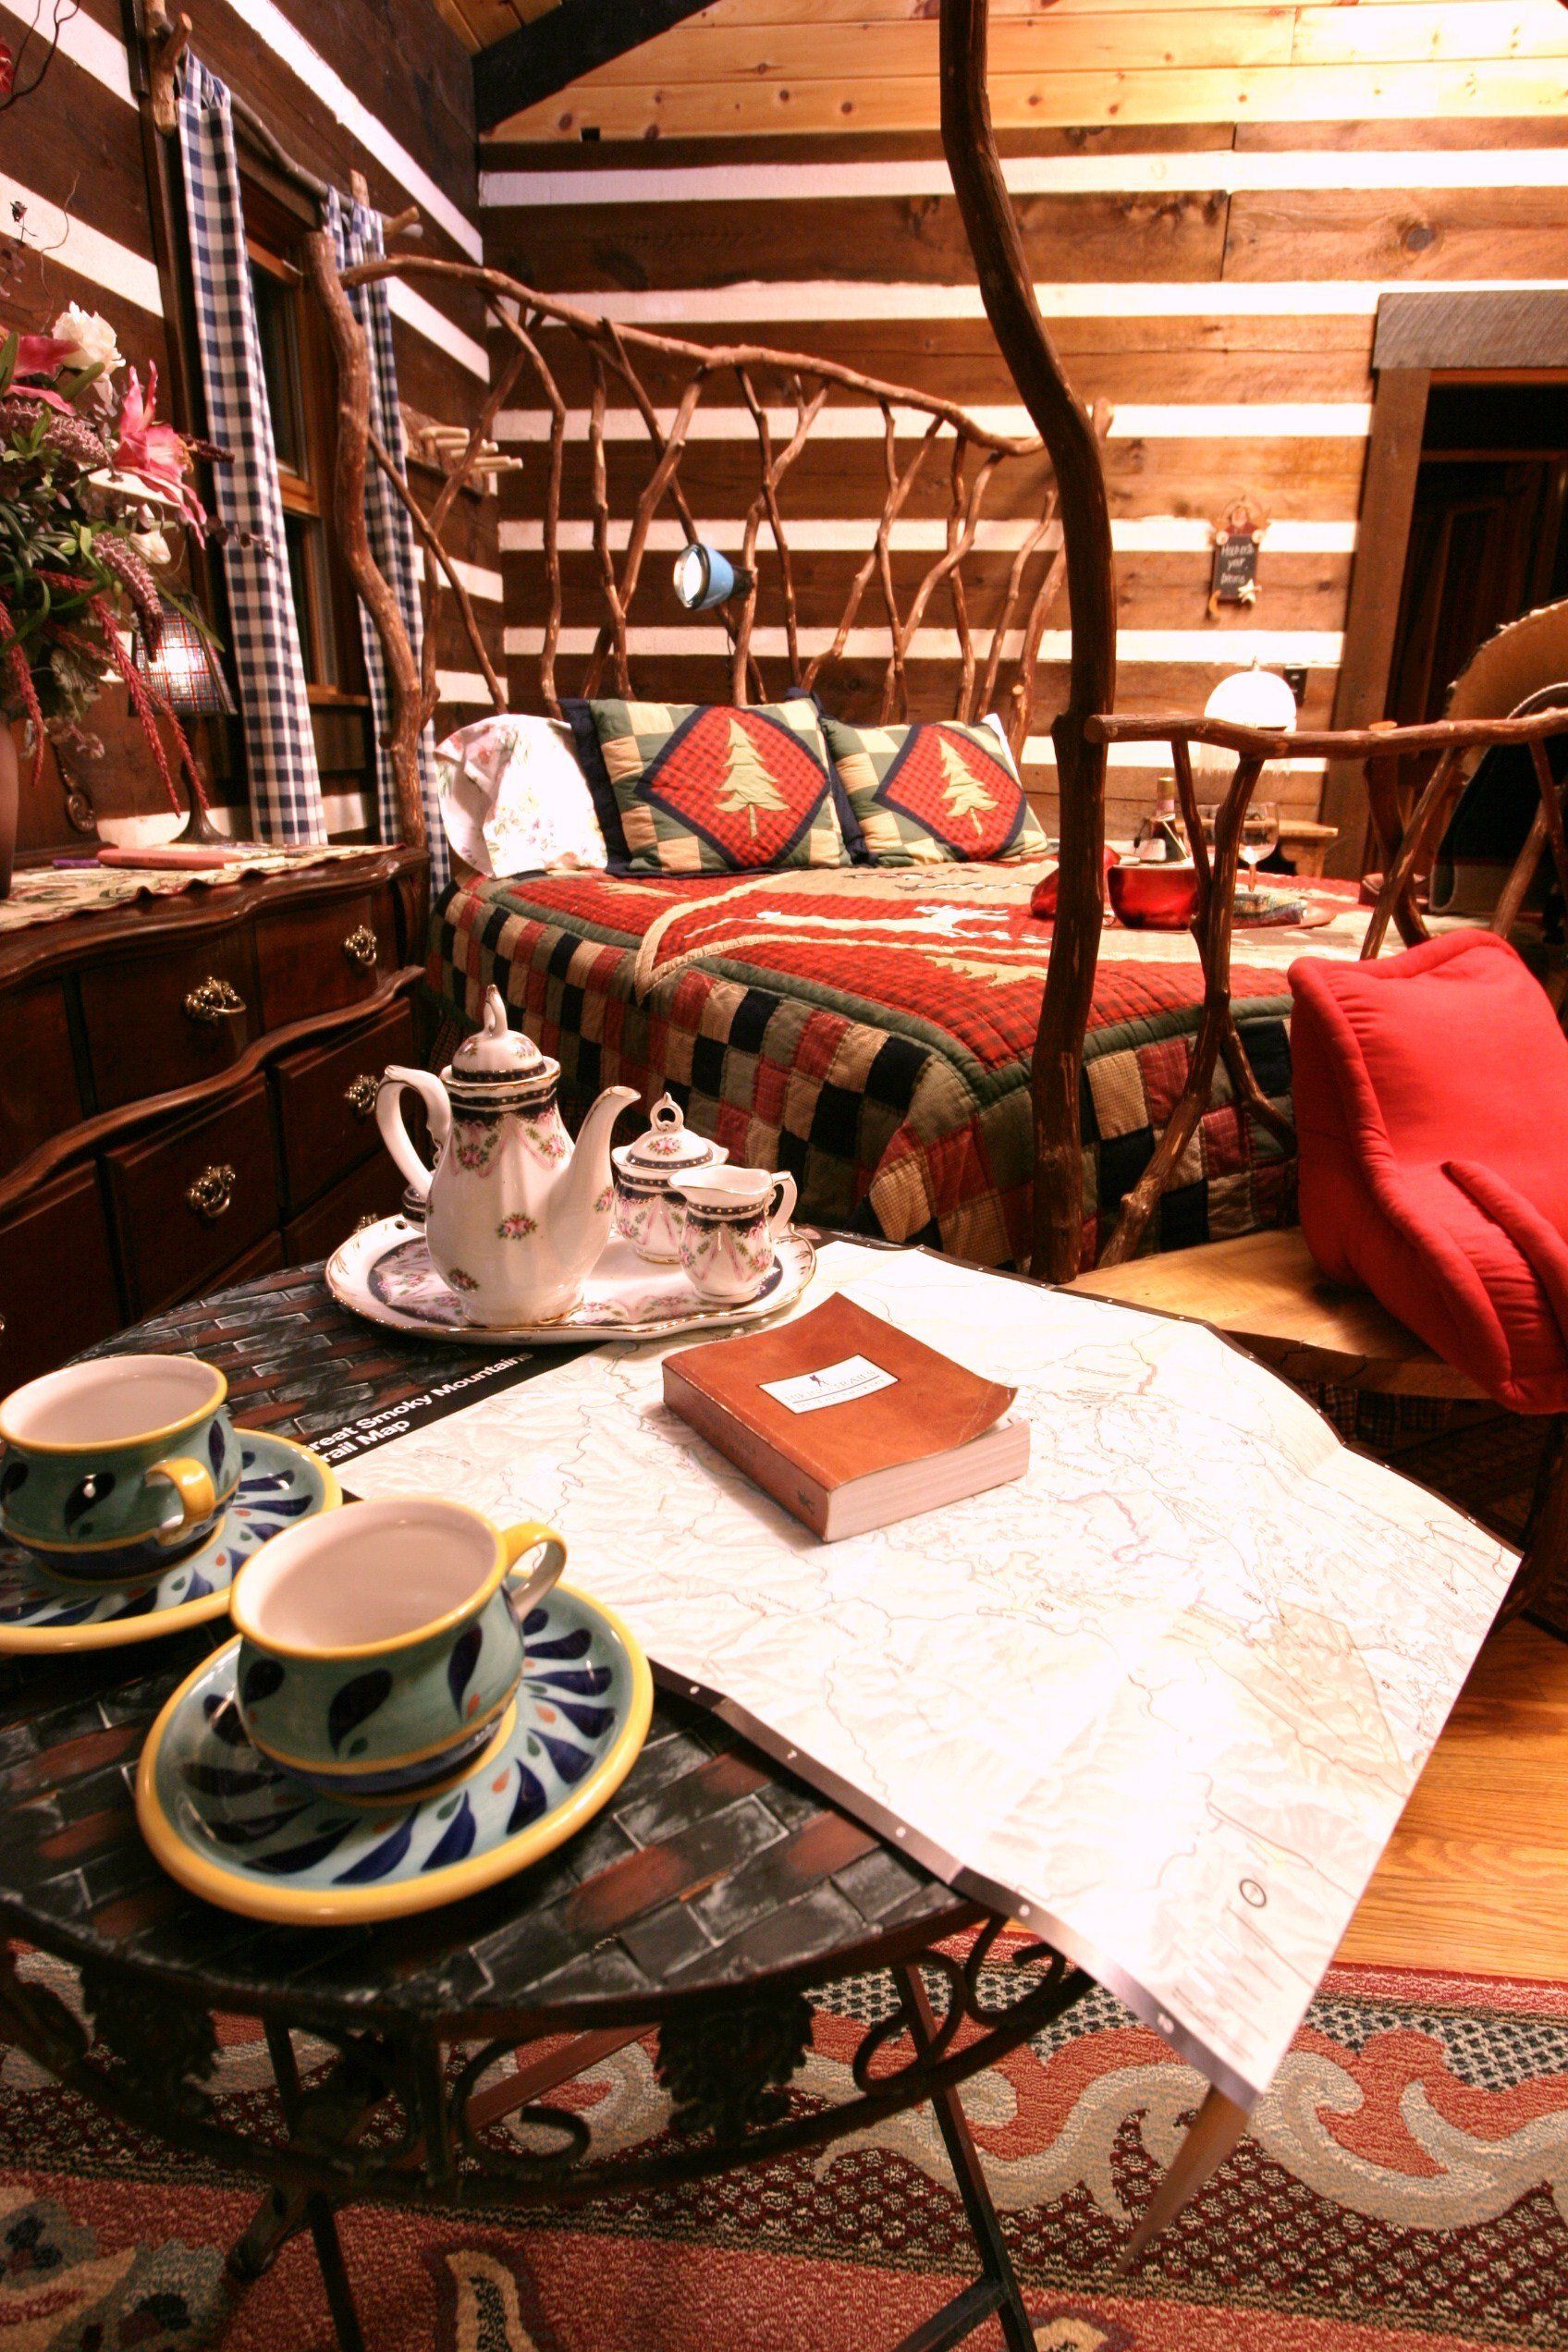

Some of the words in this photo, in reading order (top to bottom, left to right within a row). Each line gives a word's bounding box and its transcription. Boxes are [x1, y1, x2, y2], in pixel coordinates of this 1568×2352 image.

[305, 1427, 359, 1452] reat
[356, 1394, 432, 1429] Smoky
[430, 1352, 533, 1397] Mountains
[318, 1440, 359, 1463] rail
[355, 1420, 410, 1446] Map
